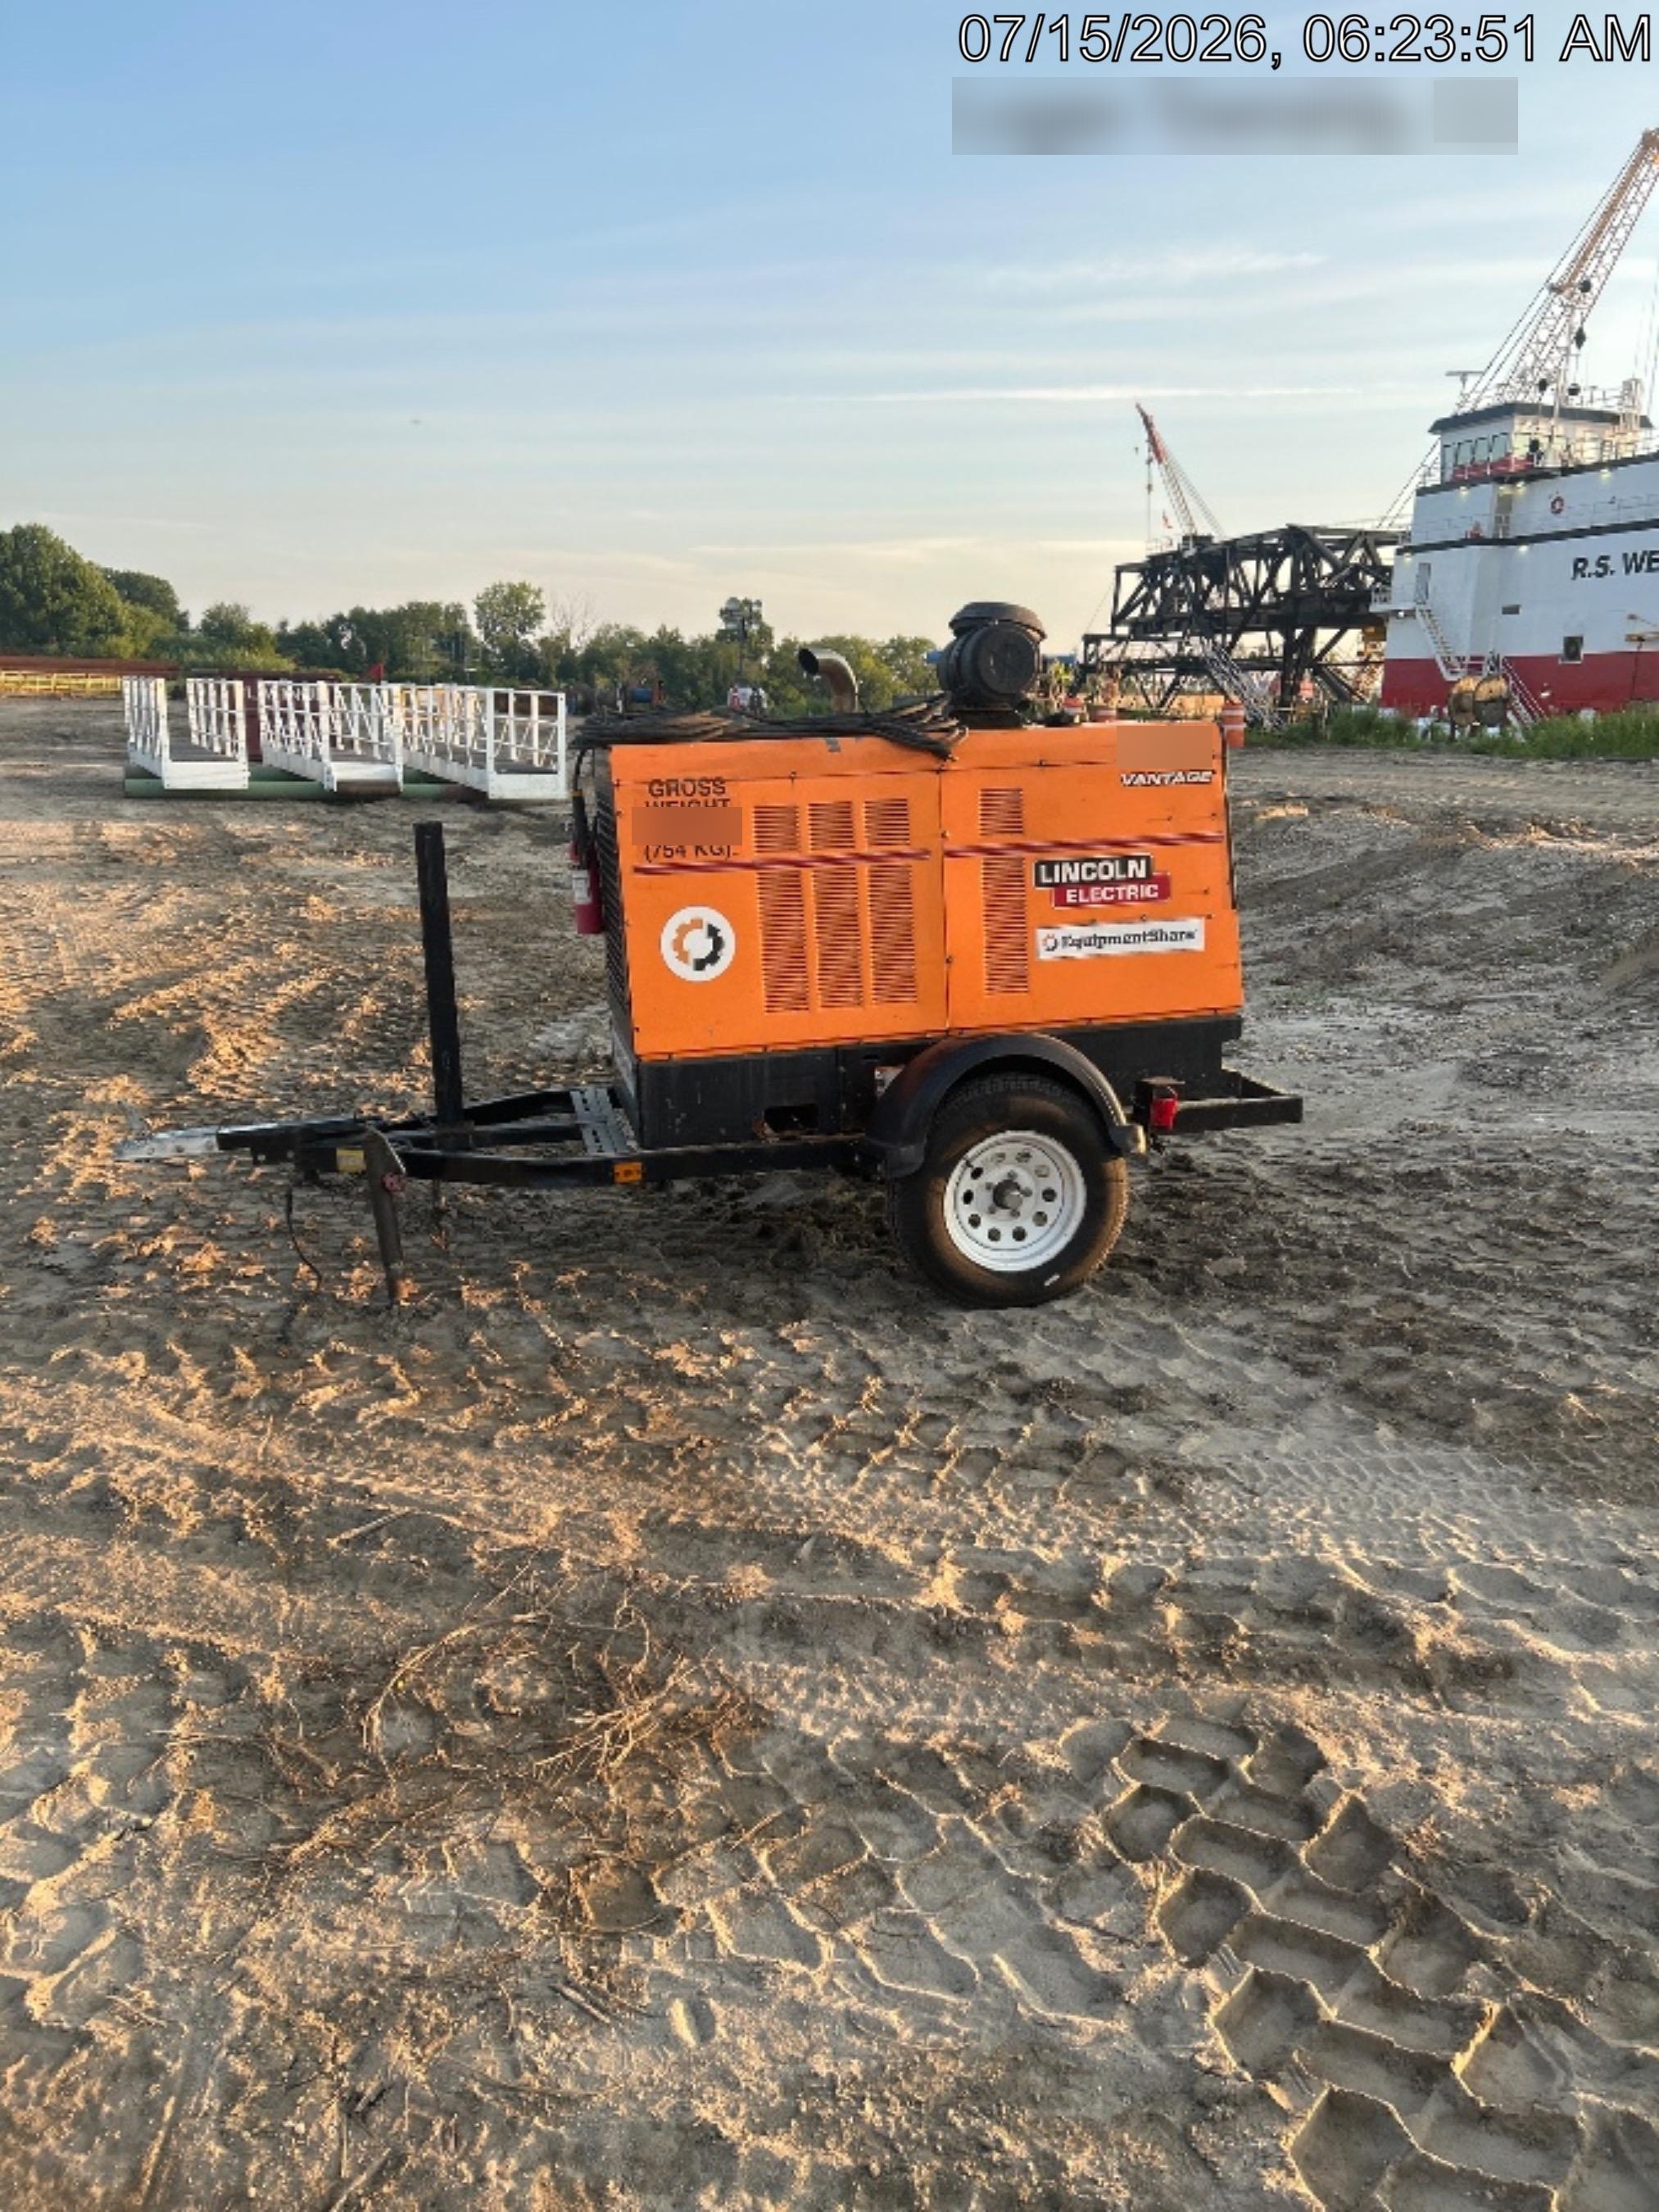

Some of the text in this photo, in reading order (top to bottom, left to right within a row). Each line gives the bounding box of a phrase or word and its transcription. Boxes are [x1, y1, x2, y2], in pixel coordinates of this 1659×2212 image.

[1571, 555, 1616, 580] R.S.
[648, 776, 726, 797] GROSS
[1120, 770, 1213, 786] VANTAGE
[1040, 859, 1146, 884] LINCOLN
[1066, 884, 1158, 903] ELECTRIC
[1061, 928, 1196, 950] EquipmentShare
